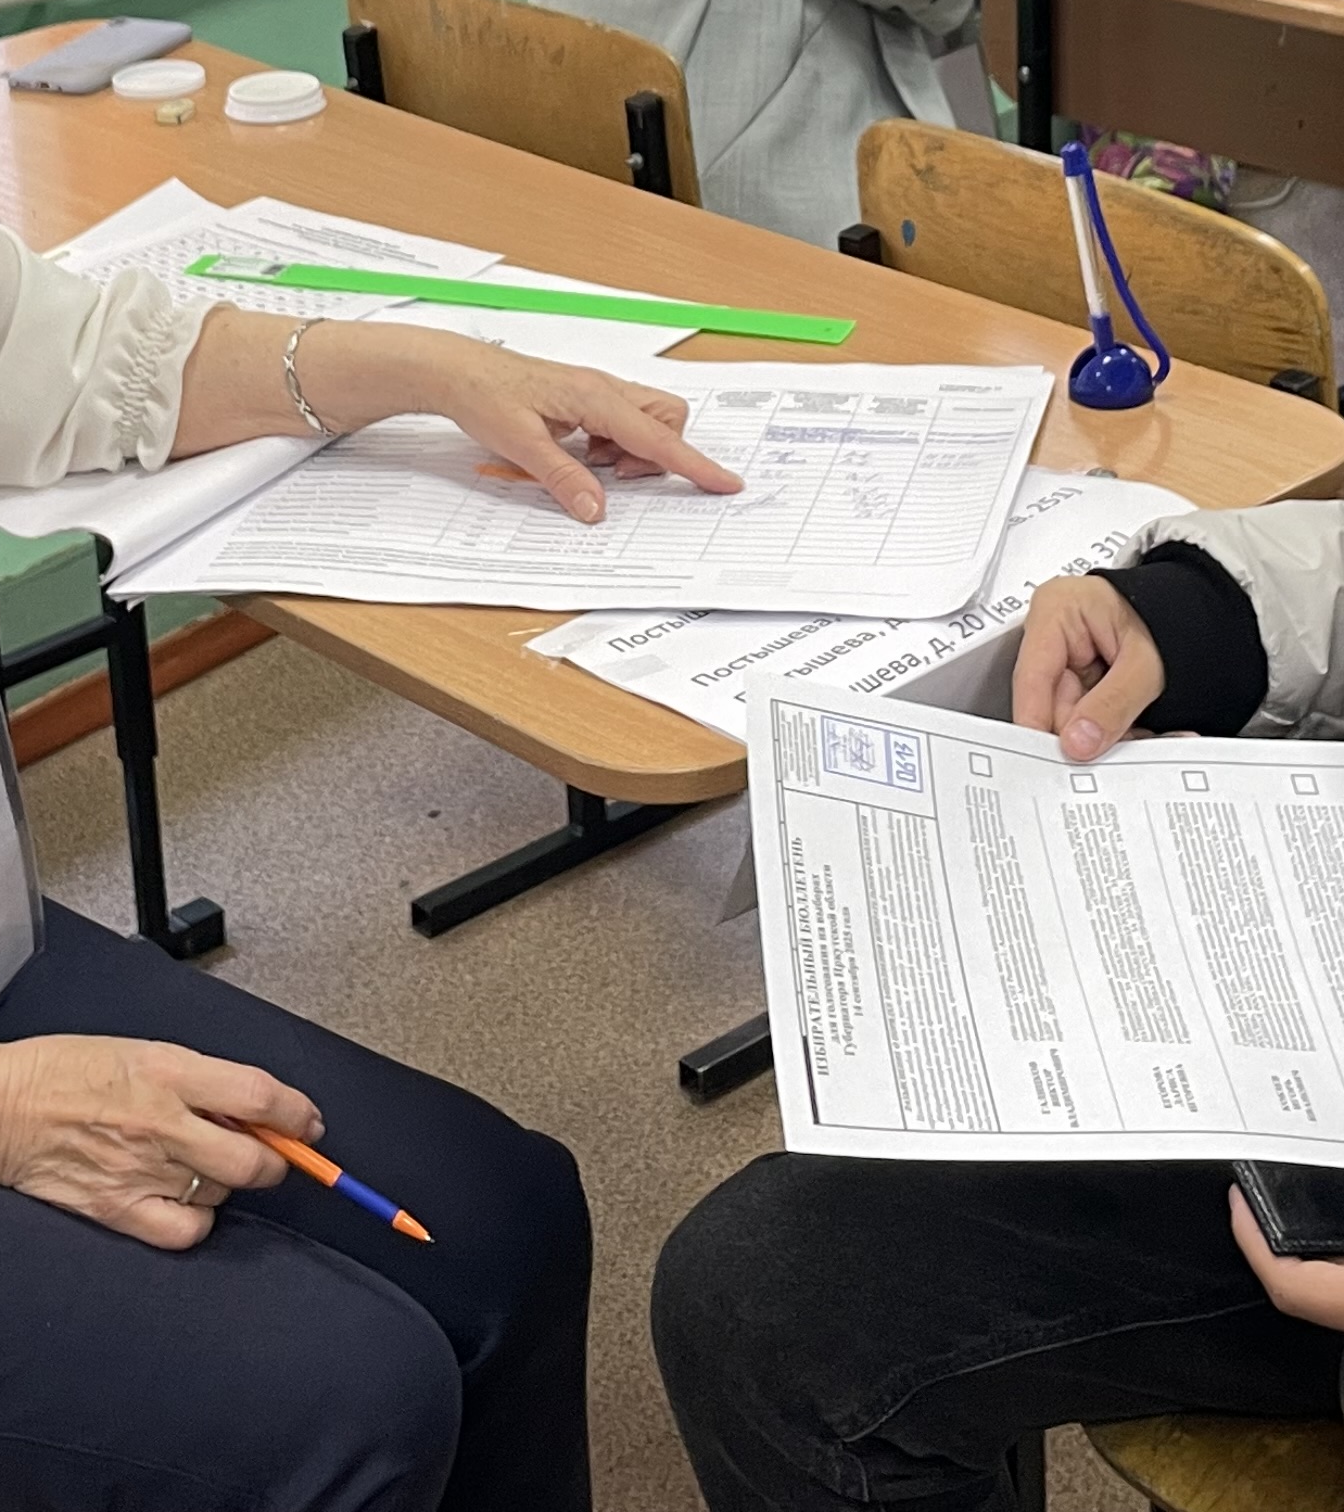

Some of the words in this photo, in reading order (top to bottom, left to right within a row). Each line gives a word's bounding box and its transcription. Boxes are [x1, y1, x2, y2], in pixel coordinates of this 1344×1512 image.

[1007, 510, 1035, 527] в.
[690, 615, 843, 688] Постышева,
[848, 650, 932, 695] шева,
[928, 637, 957, 658] д.
[948, 613, 986, 639] 20
[979, 595, 1030, 625] (кв.
[791, 836, 812, 934] БЮЛЛЕТЕНЬ
[799, 937, 830, 1076] ИЗБИРАТЕЛЬНЫЙ
